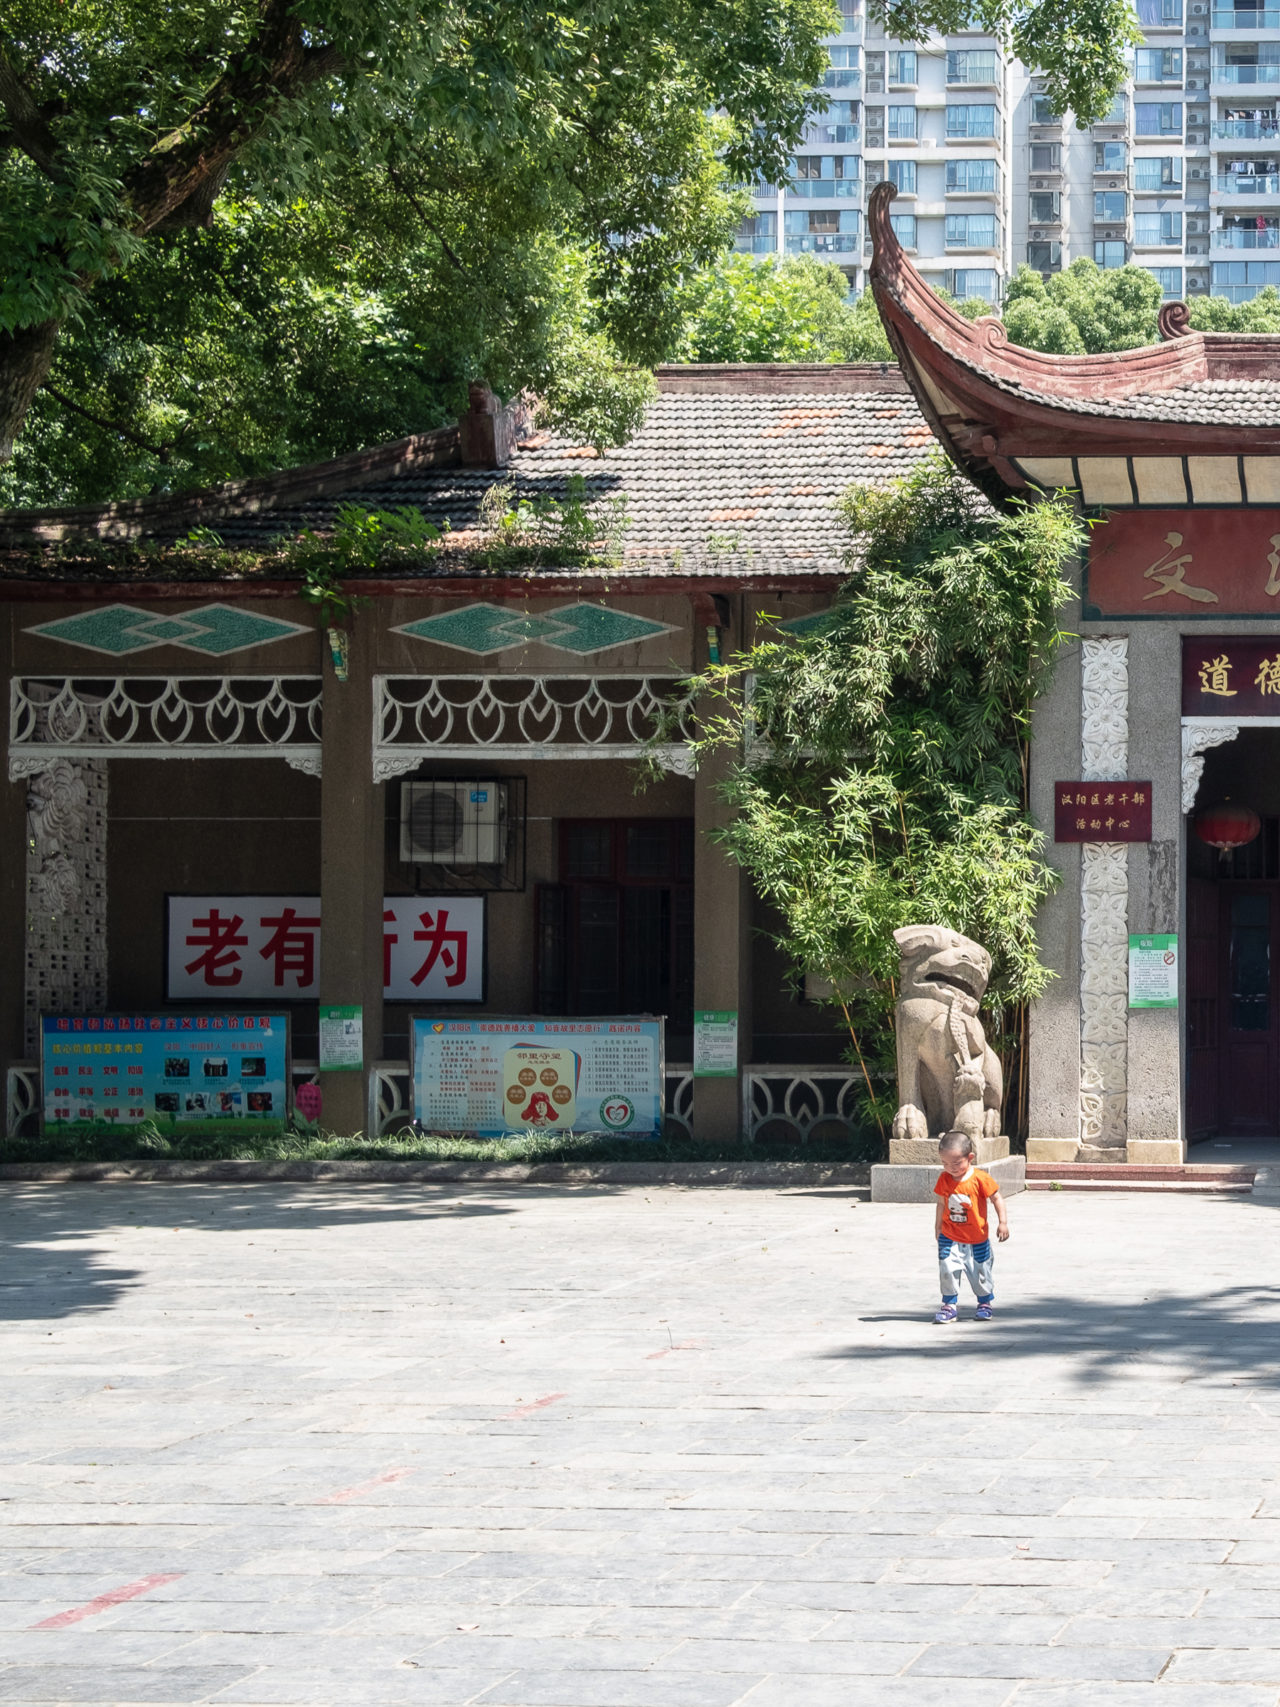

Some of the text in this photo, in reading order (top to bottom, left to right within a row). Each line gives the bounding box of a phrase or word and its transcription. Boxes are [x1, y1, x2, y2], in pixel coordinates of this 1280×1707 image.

[1061, 792, 1145, 806] 汉阳区老干部
[1076, 816, 1130, 831] 活动中心
[184, 908, 469, 988] 老有为
[56, 1017, 271, 1031] 培育和弘扬社会主义核心价值观
